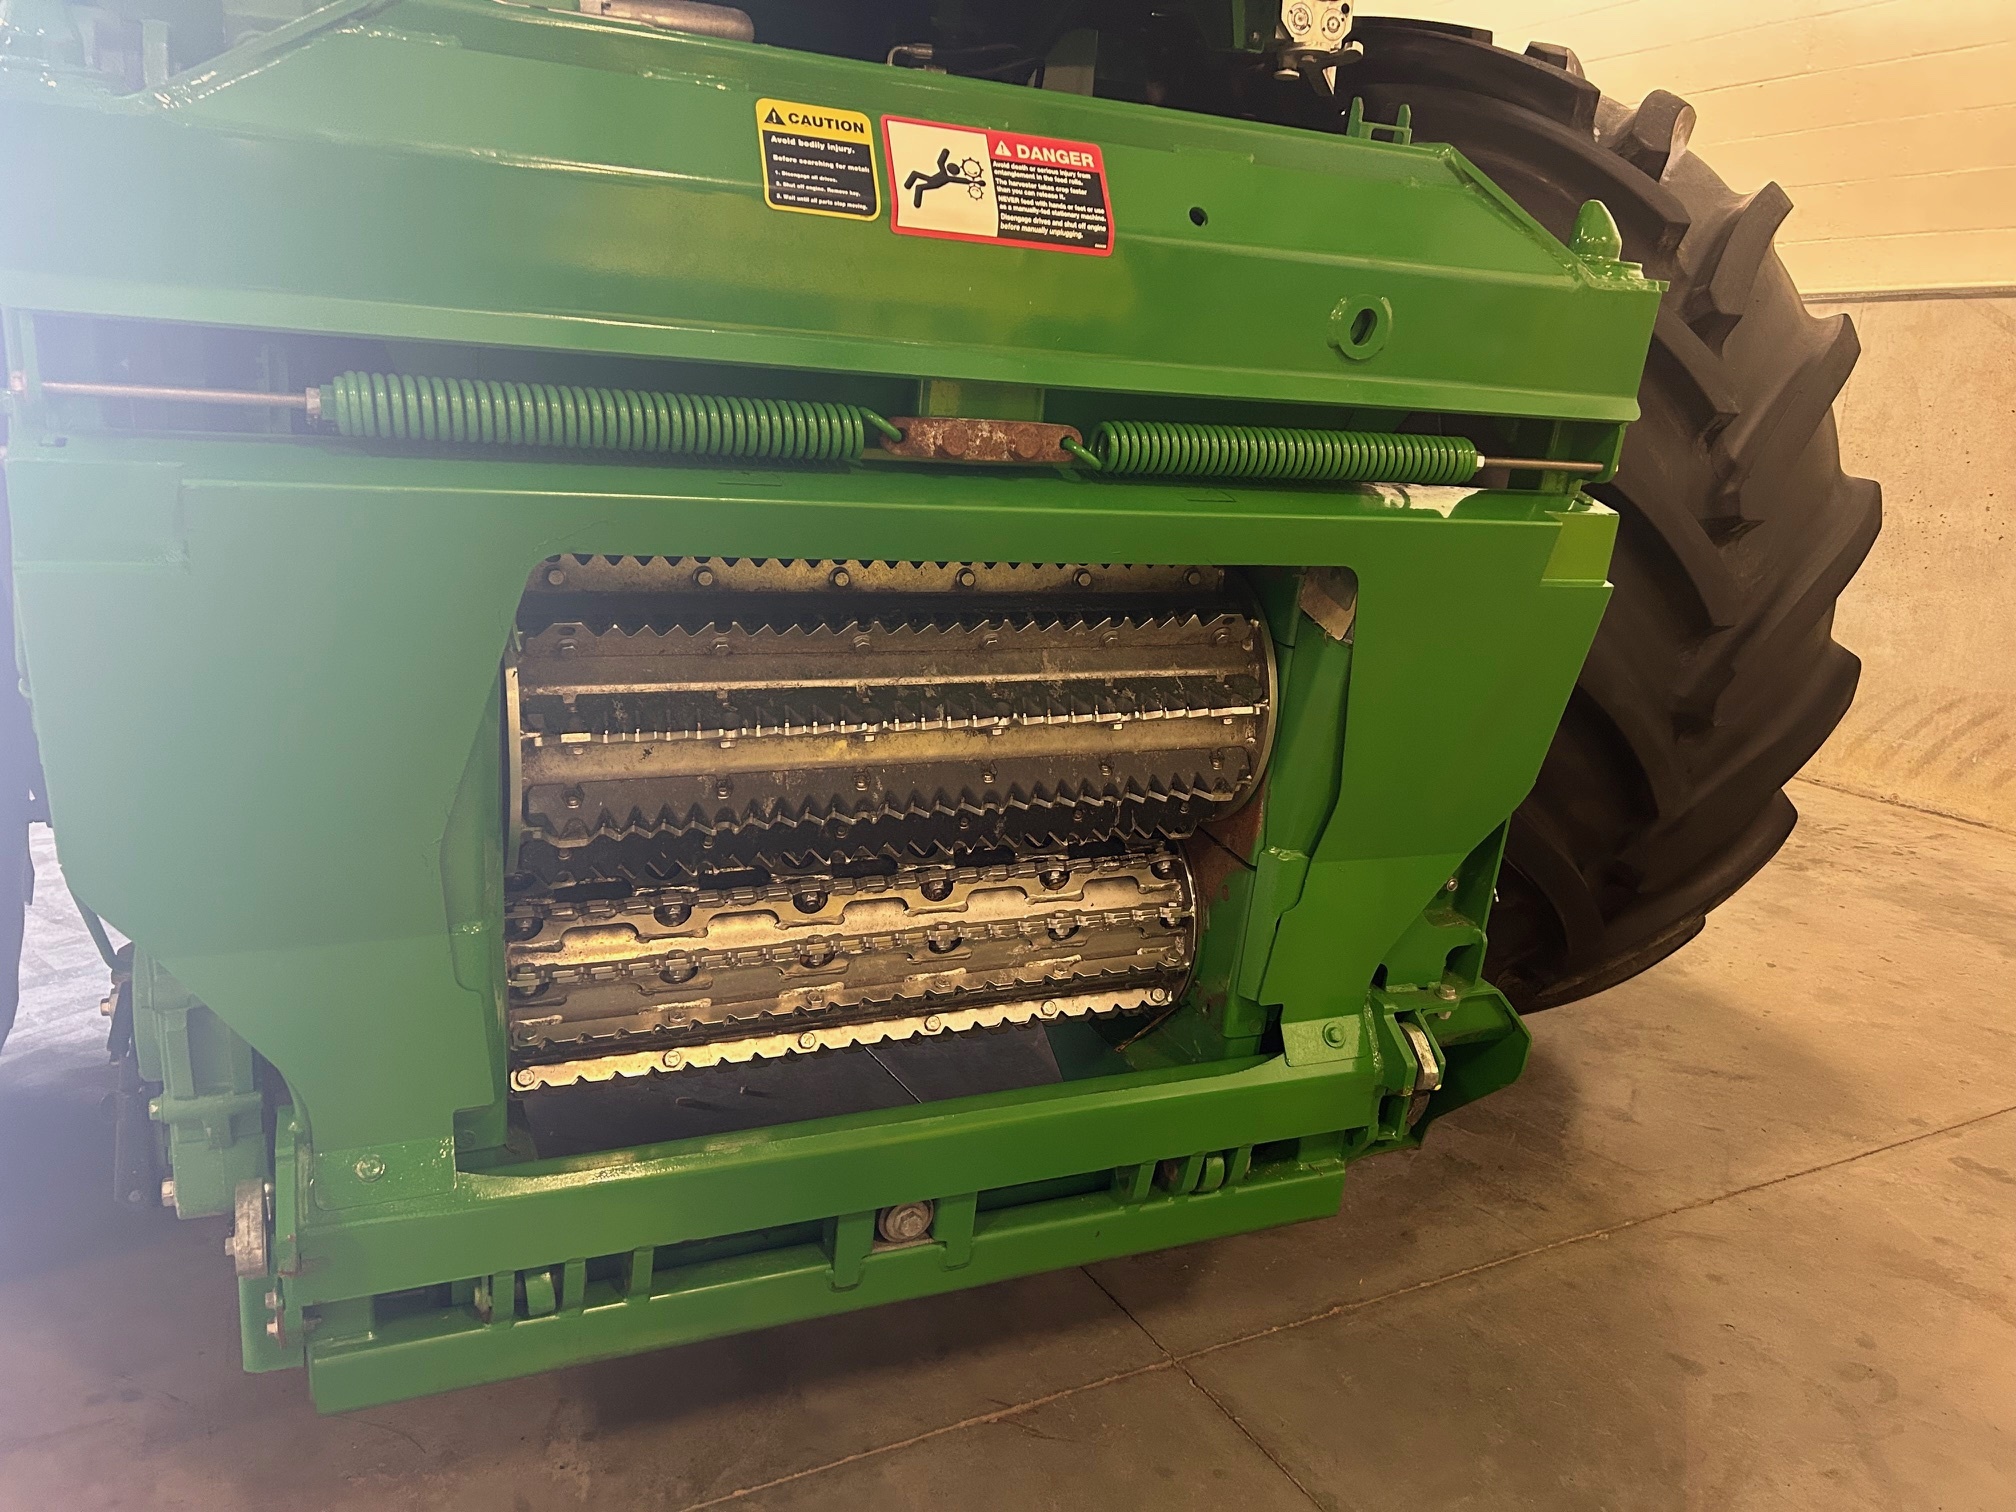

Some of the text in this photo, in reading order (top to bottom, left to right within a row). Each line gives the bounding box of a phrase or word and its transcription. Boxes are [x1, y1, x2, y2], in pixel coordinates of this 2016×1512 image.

[788, 113, 864, 134] CAUTION
[771, 135, 855, 154] Avoid bodily injury.
[773, 154, 797, 163] Before
[799, 158, 834, 169] searching
[1016, 144, 1094, 168] DANGER
[782, 170, 810, 180] Disengage
[994, 170, 1035, 180] entanglement
[1060, 169, 1076, 178] injury
[1008, 180, 1037, 189] harvester
[1037, 191, 1058, 199] release
[1049, 201, 1066, 209] hands
[1000, 213, 1031, 223] Disengage
[1033, 216, 1051, 225] drives
[1013, 205, 1050, 215] manually-fed
[1052, 210, 1079, 219] stationary
[1081, 213, 1106, 222] machine.
[1001, 222, 1083, 239] before manually unplugging.
